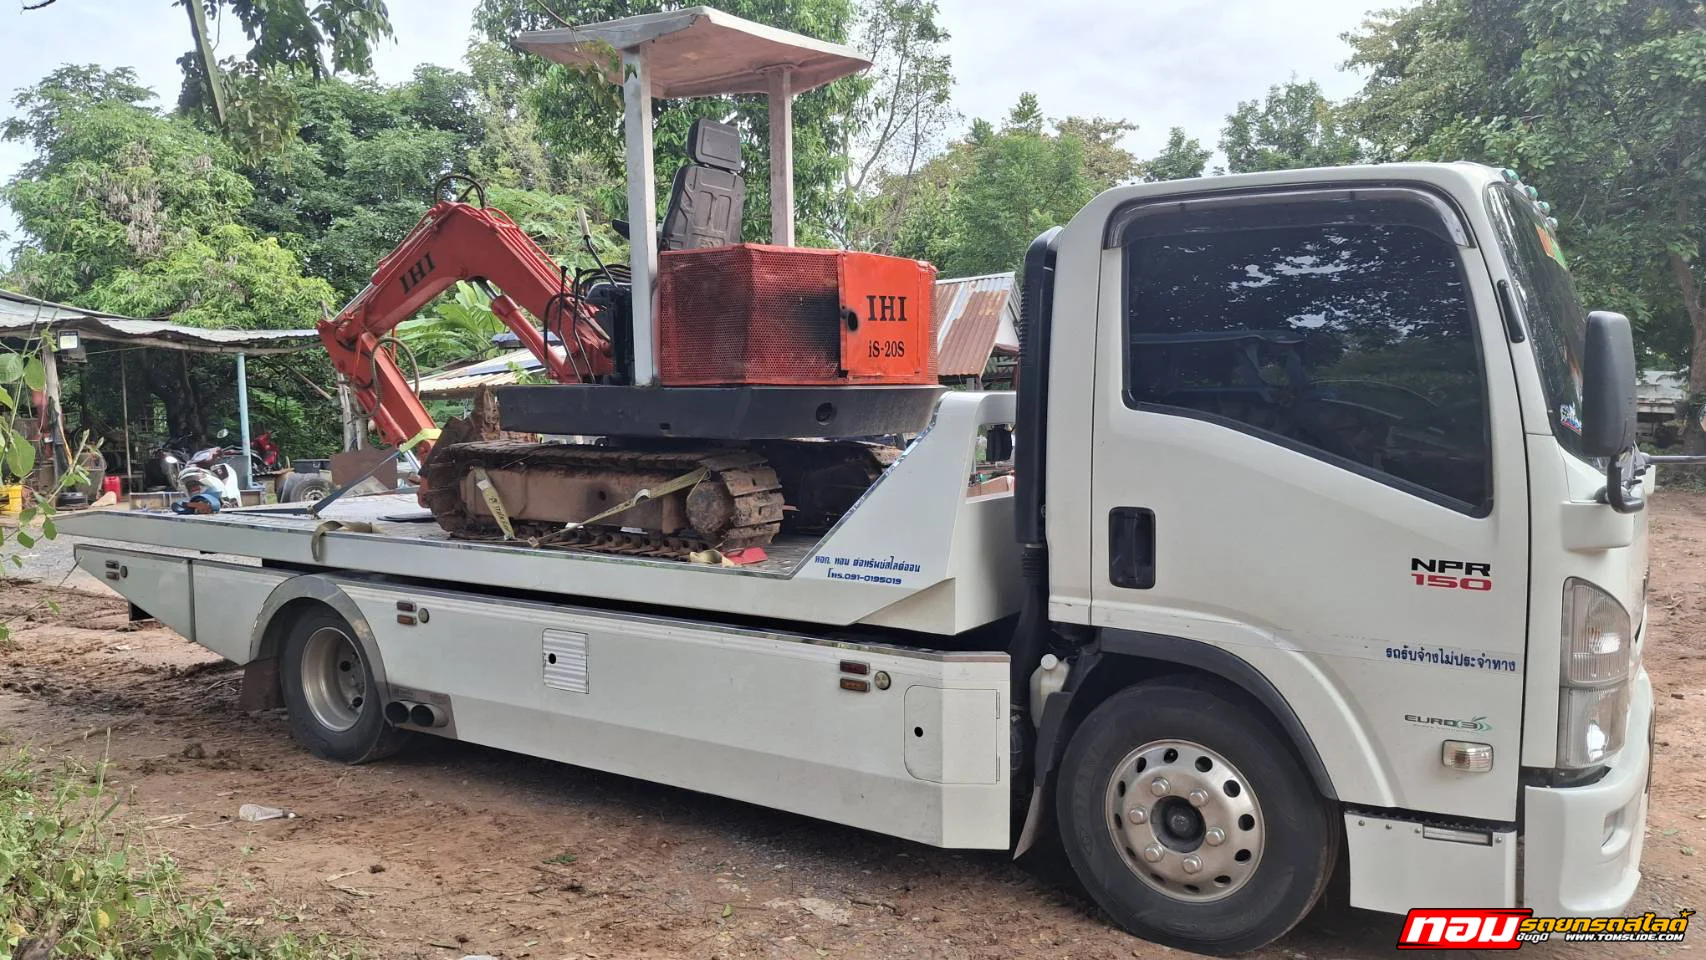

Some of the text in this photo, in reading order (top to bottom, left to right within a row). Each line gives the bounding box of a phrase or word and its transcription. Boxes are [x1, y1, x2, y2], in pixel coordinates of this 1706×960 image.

[399, 251, 436, 295] IHI
[866, 295, 907, 321] IHI
[868, 340, 905, 358] iS-20S
[1411, 558, 1491, 577] NPR
[1411, 573, 1492, 592] 150
[1386, 645, 1516, 671] รถรับจ้างไม่ประจำทาง
